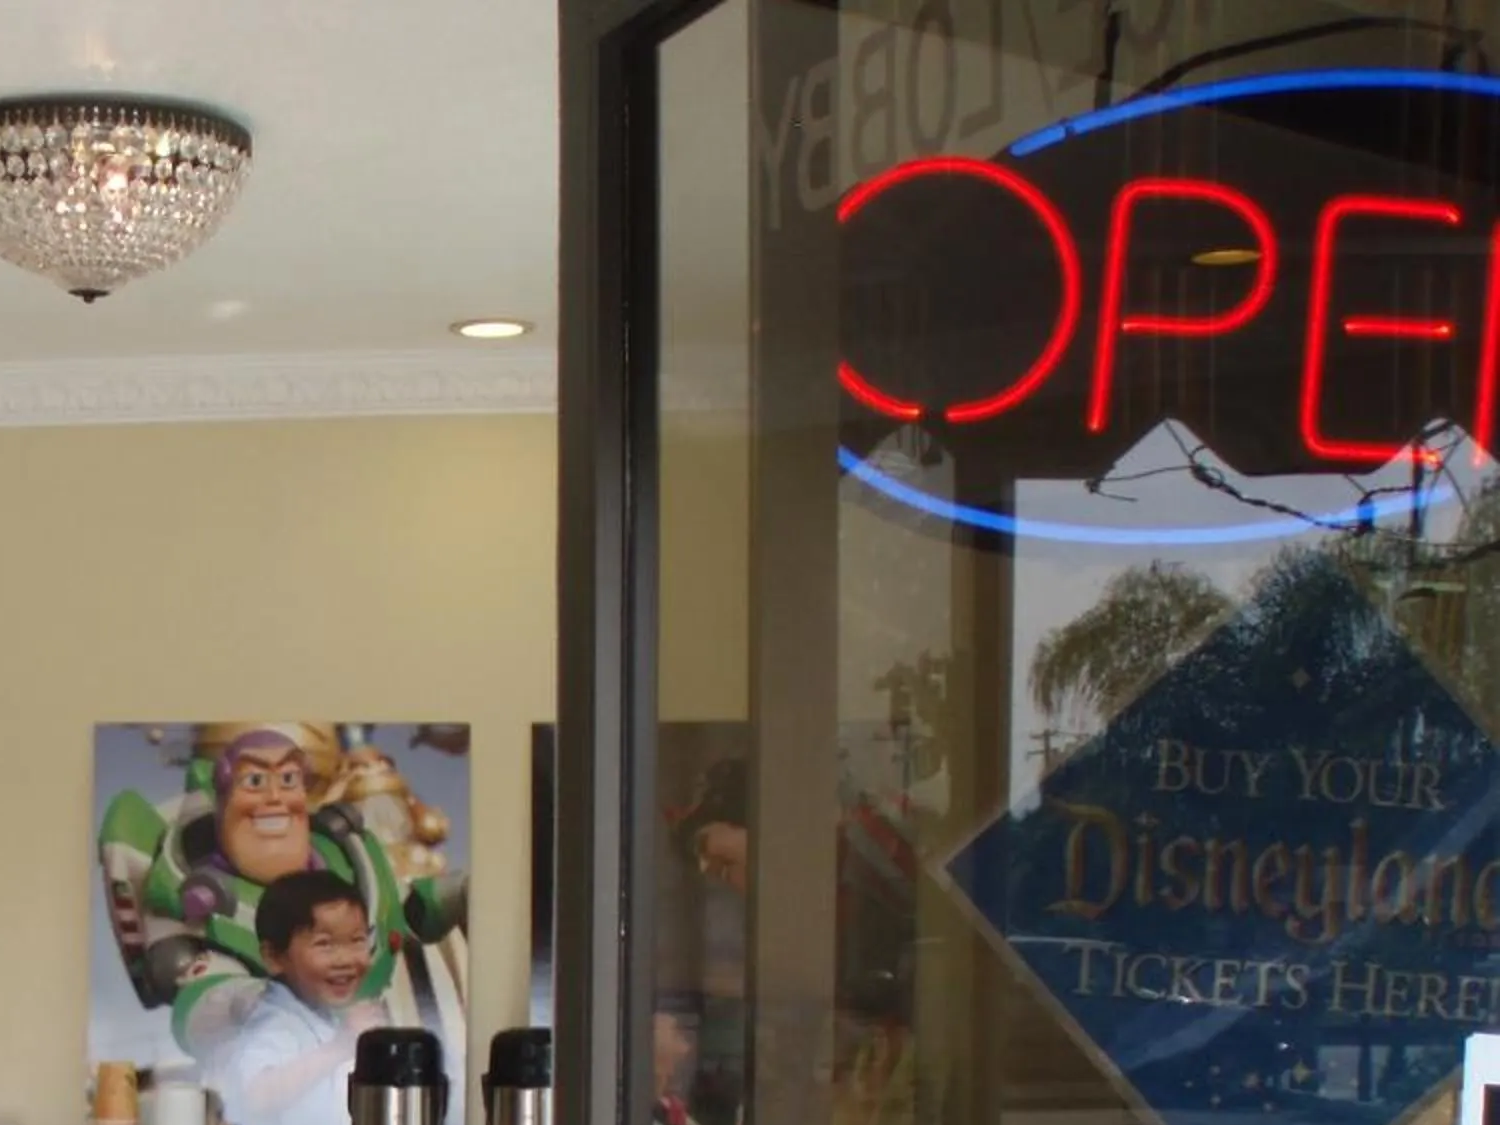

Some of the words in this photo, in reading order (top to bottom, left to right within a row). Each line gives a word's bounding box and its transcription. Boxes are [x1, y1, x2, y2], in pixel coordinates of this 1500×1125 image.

[838, 155, 1500, 468] OPE
[1153, 738, 1271, 798] BUY
[1290, 745, 1446, 811] YOUR
[1063, 939, 1311, 1010] TICKETS
